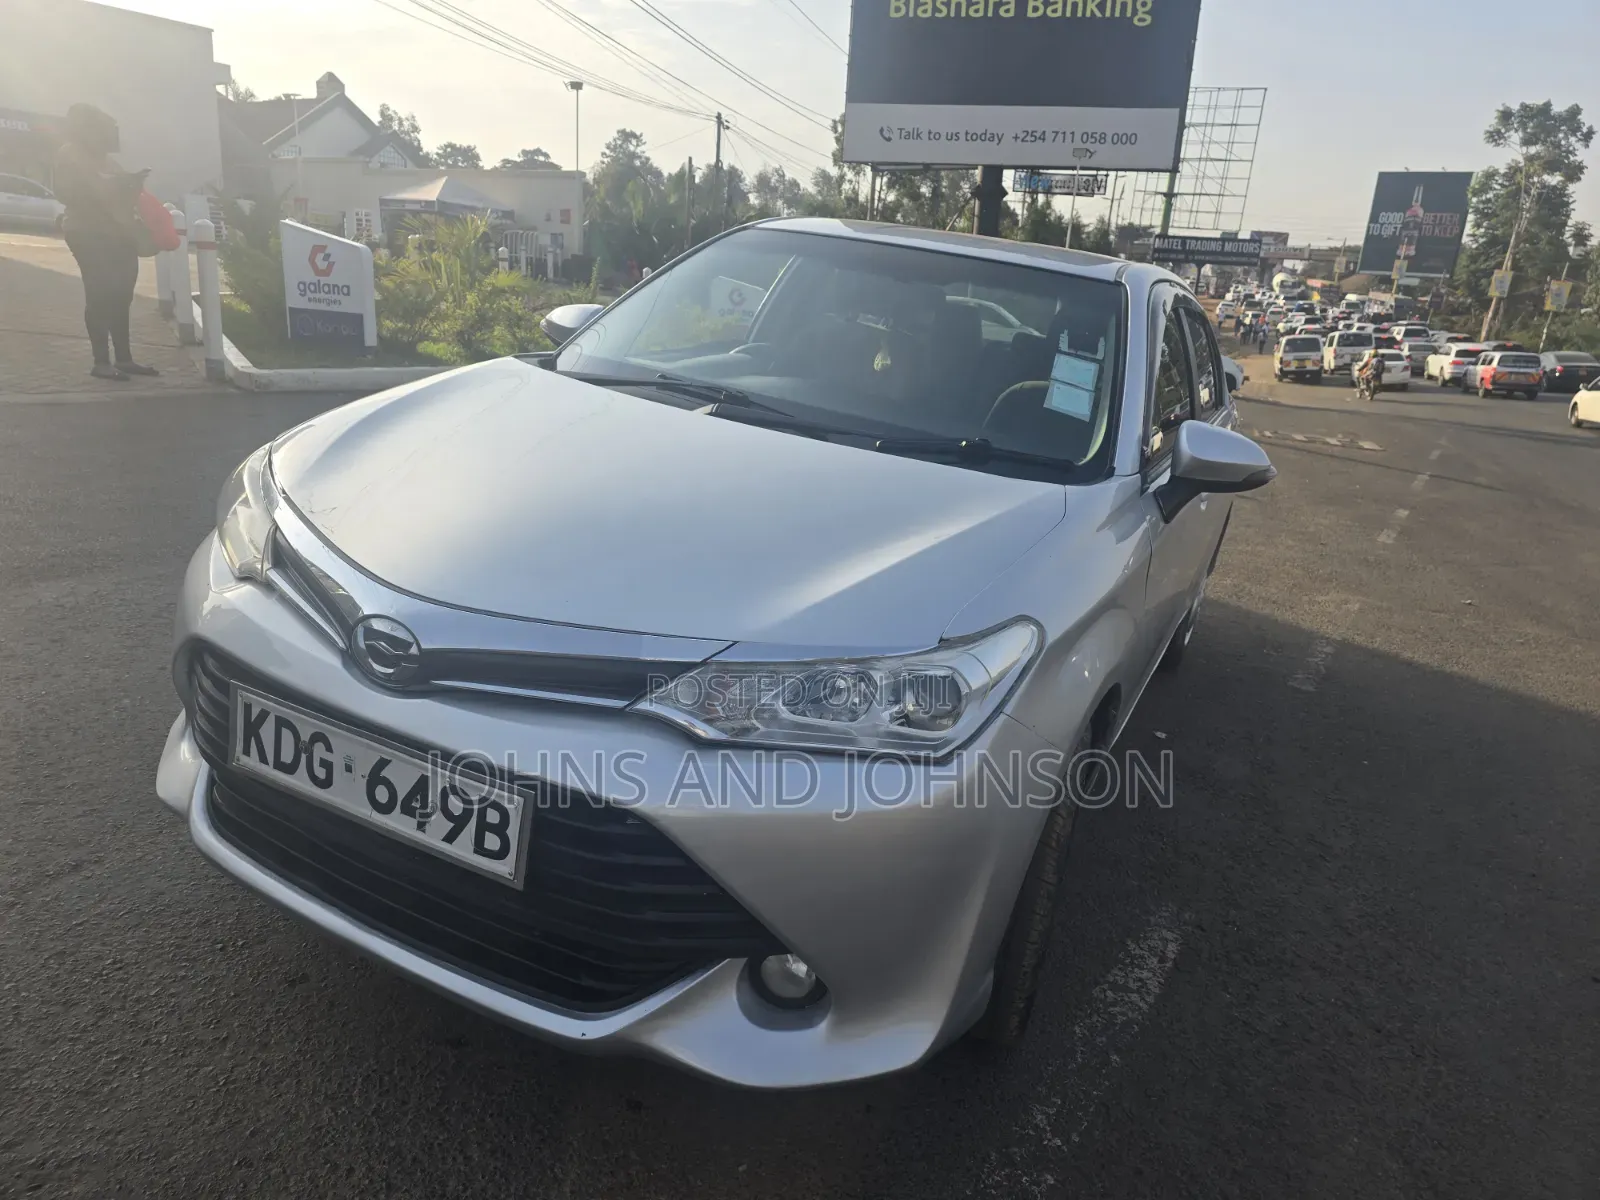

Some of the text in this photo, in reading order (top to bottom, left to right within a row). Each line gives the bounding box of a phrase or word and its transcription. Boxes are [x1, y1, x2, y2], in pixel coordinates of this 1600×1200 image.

[1026, 0, 1153, 26] Banking
[897, 128, 1138, 145] Talk to us today +254 711 058 000
[1379, 212, 1404, 224] GOOD
[1423, 213, 1459, 224] BETTER
[1368, 223, 1403, 237] TO GIFT
[1421, 225, 1459, 237] TO KEEP
[1155, 238, 1182, 250] MATEL
[1186, 239, 1222, 252] TRADING
[1224, 242, 1260, 253] MOTORS
[297, 279, 351, 297] galana
[307, 296, 342, 306] energies
[241, 700, 511, 861] KDG 649B
